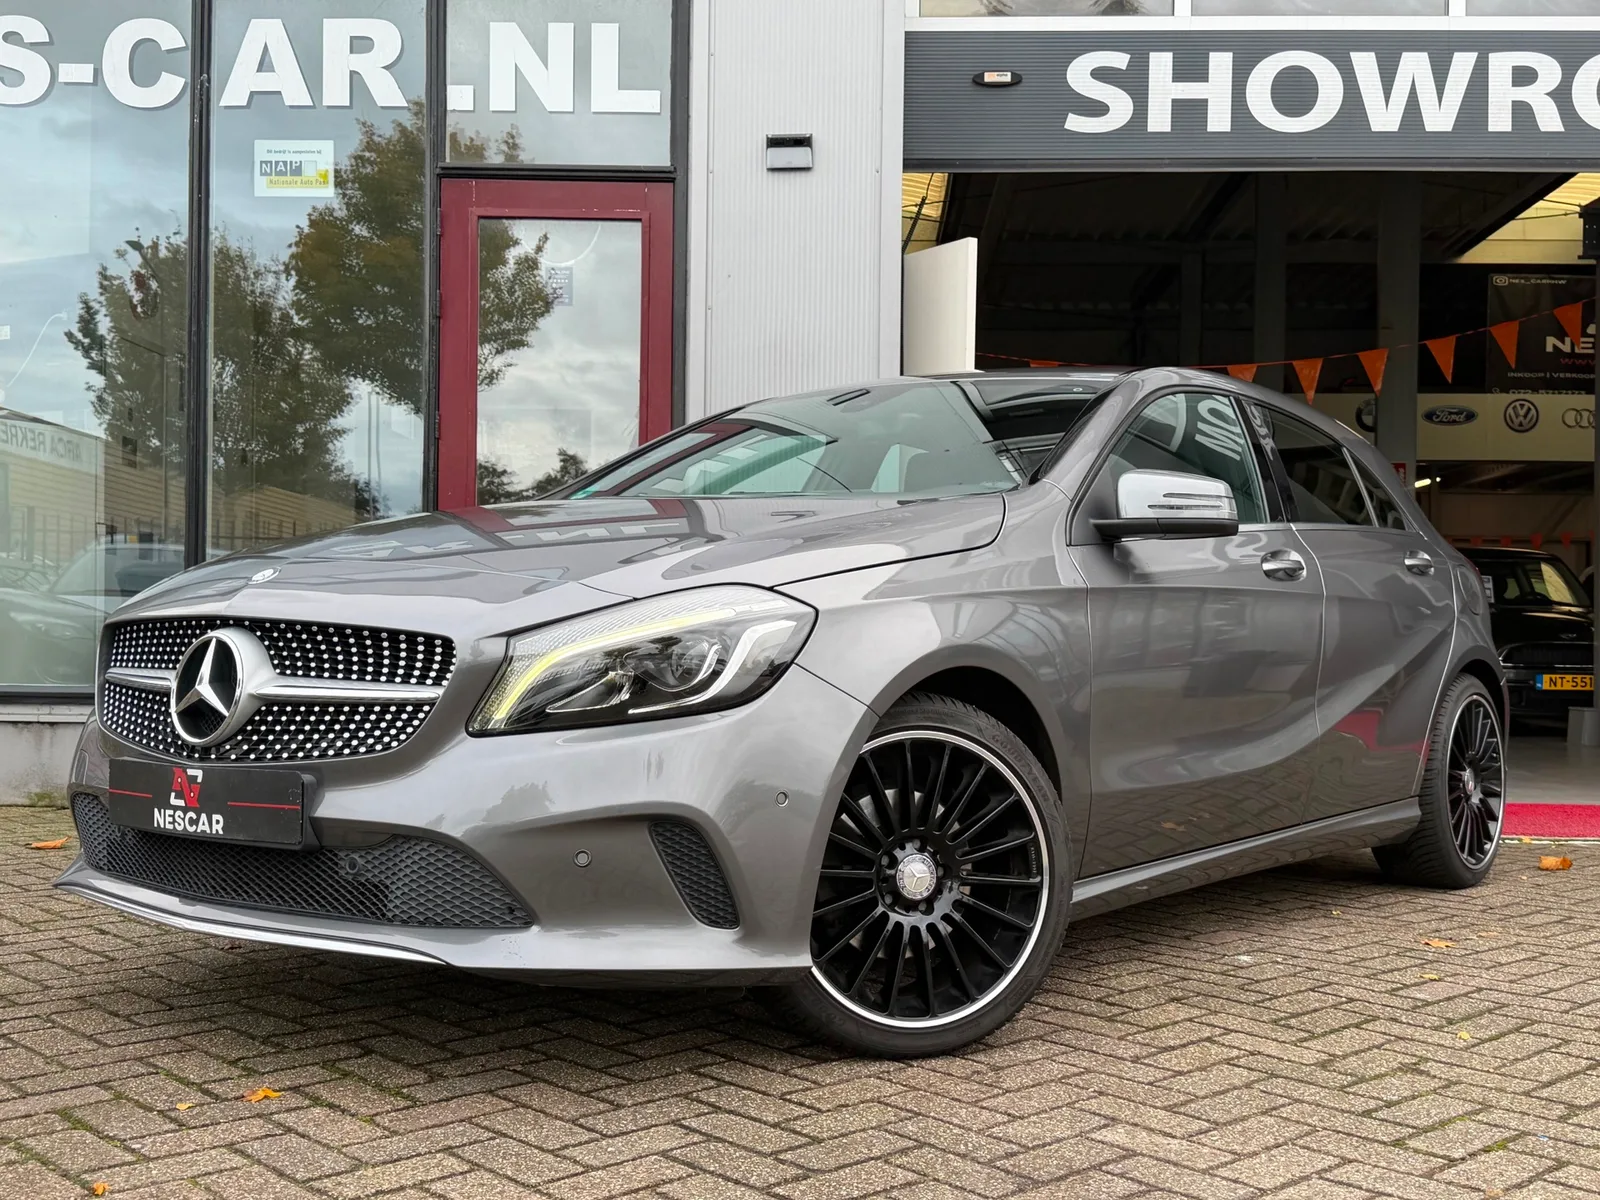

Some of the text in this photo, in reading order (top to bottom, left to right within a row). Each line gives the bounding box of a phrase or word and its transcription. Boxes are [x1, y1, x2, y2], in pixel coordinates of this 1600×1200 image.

[261, 159, 301, 174] NAP
[1432, 406, 1468, 422] Ford
[153, 807, 224, 835] NESCAR
